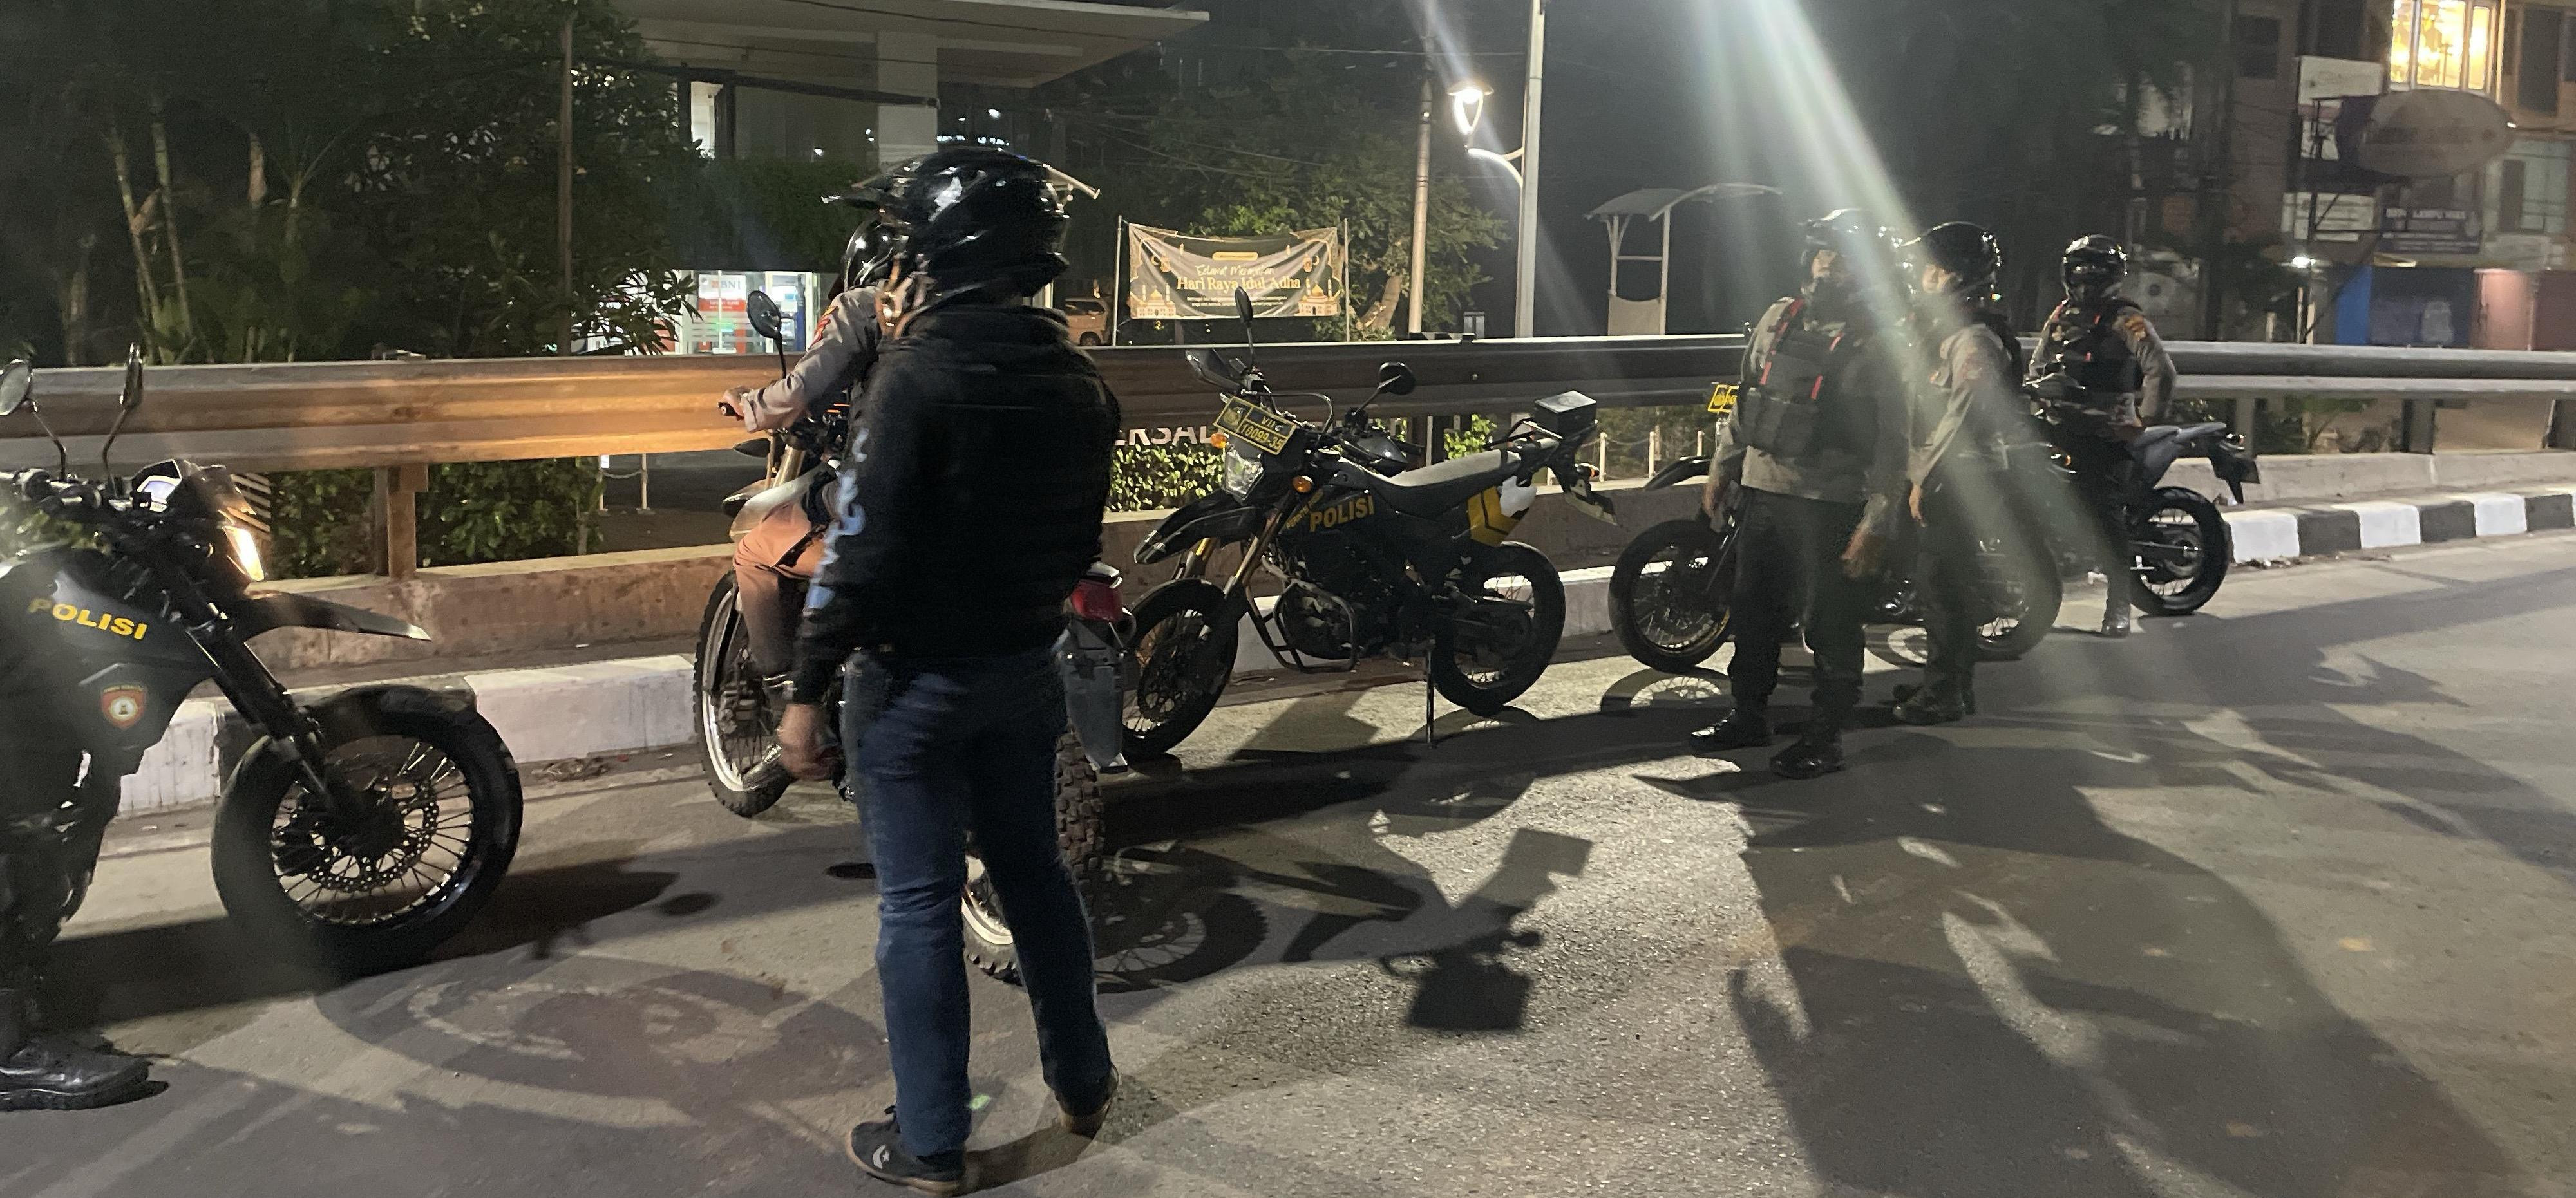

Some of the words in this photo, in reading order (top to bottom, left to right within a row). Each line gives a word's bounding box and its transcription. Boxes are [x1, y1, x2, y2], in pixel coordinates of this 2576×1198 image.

[721, 280, 741, 289] BNI
[1177, 276, 1206, 290] Hari
[1208, 277, 1240, 294] Raya
[1241, 276, 1265, 290] Idul
[1269, 275, 1301, 289] Adha
[1309, 495, 1375, 532] POLISI
[28, 597, 148, 640] POLISI
